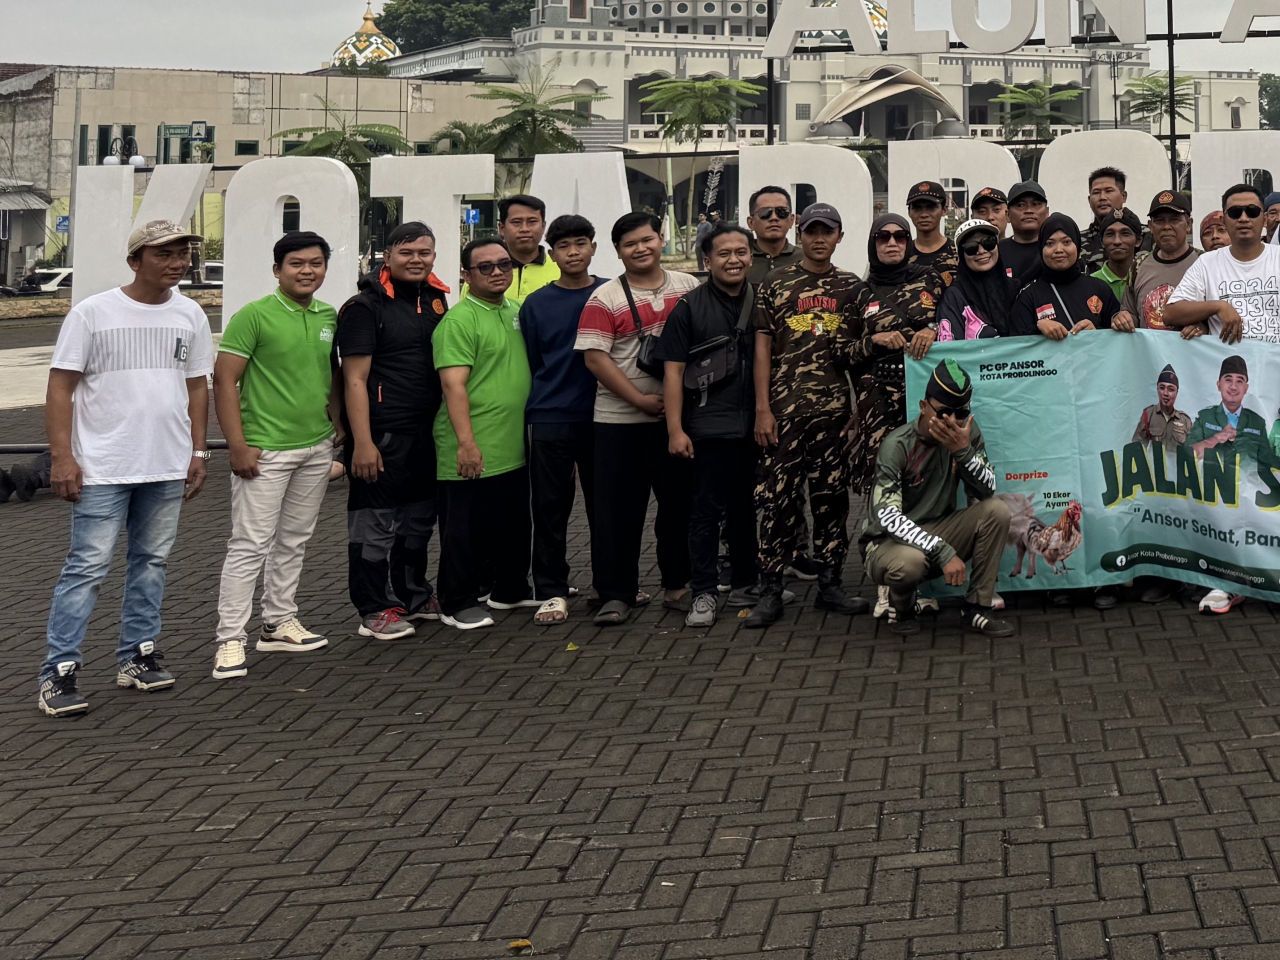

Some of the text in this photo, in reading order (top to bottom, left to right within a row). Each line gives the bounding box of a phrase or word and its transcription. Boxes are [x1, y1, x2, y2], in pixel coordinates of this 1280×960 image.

[1227, 296, 1279, 317] 934
[979, 360, 1045, 373] PC GP ANSOR
[979, 368, 1058, 381] KOTA PROBOLINGGO
[1005, 470, 1049, 482] Dorprize
[1100, 442, 1240, 508] JALAN
[1043, 491, 1071, 500] 10 Ekor
[1045, 500, 1070, 509] Ayam
[1133, 508, 1189, 530] "Ansor
[1191, 519, 1240, 547] Sehat,
[1140, 549, 1155, 557] Kota
[1155, 550, 1188, 565] Probolinggo
